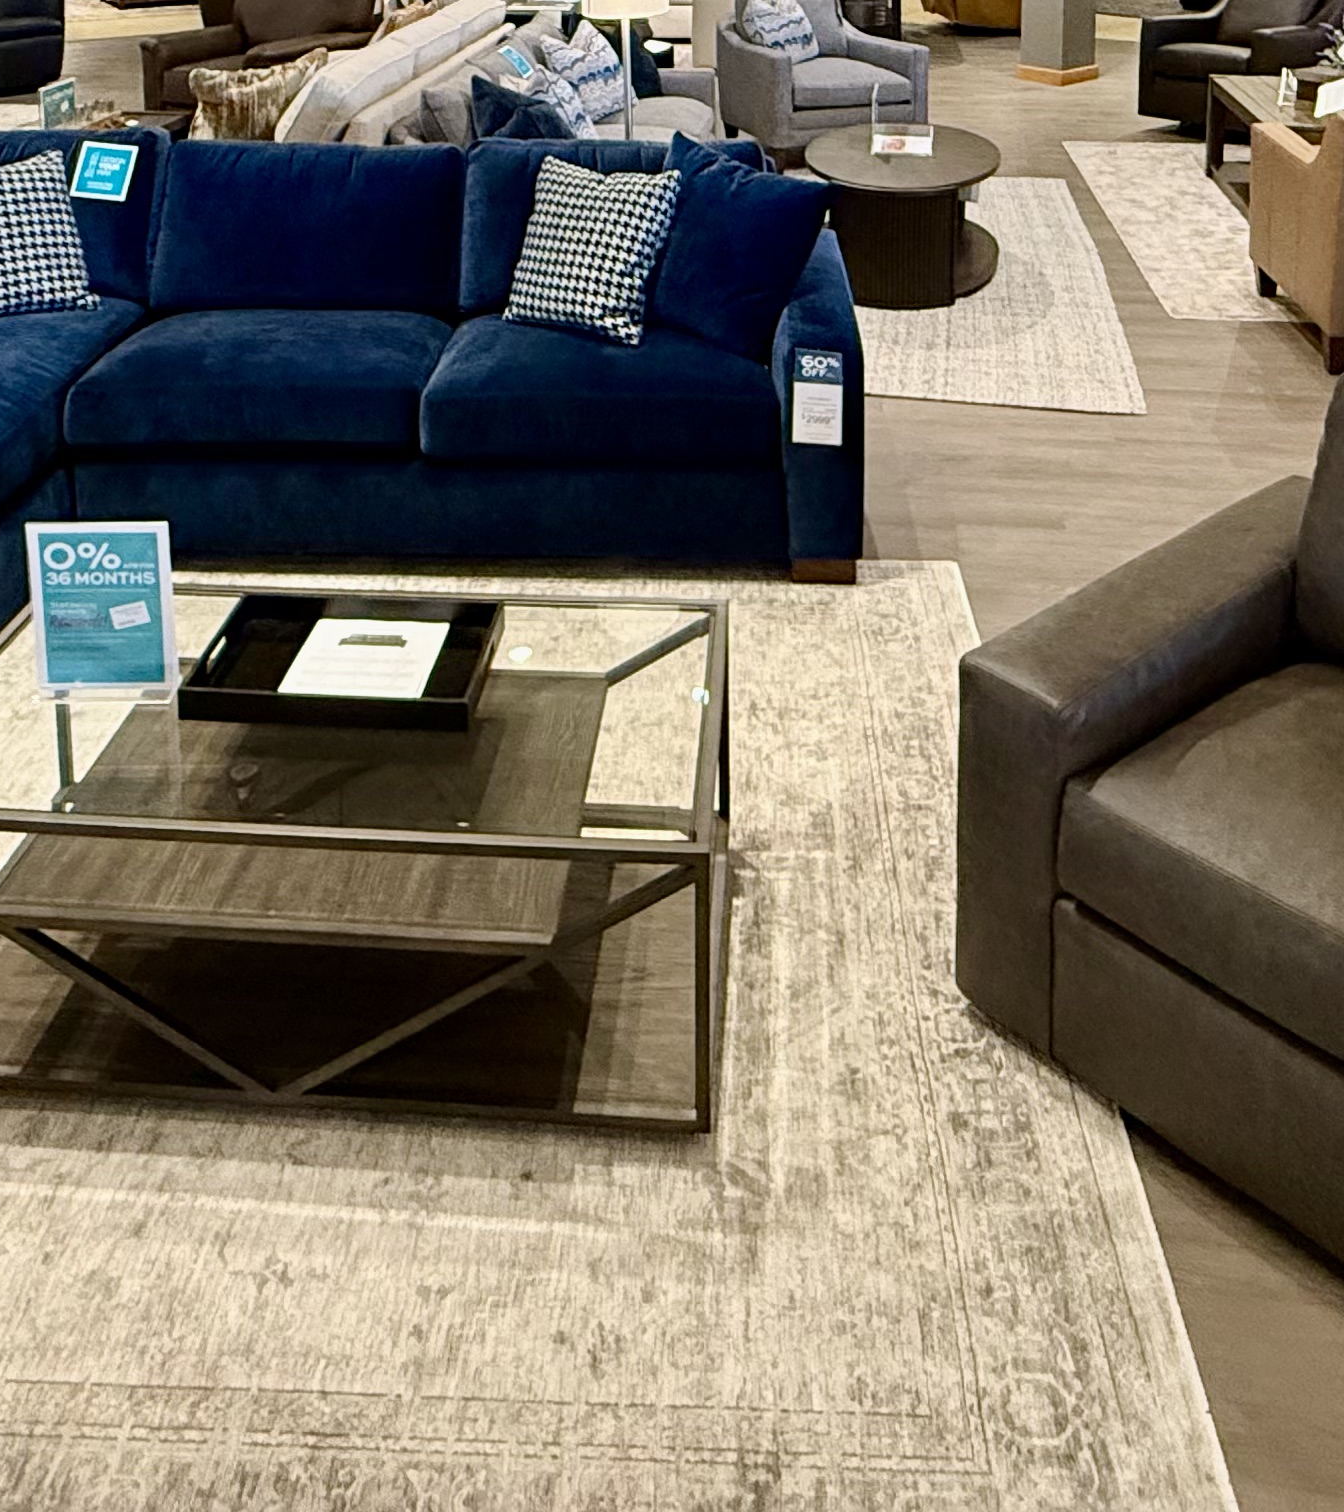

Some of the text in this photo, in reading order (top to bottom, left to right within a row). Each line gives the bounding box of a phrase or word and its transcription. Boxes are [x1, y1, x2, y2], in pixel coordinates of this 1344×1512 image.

[801, 355, 840, 368] 60%
[801, 367, 828, 377] OFF
[43, 542, 122, 571] 0%
[45, 571, 156, 585] 36 MONTHS
